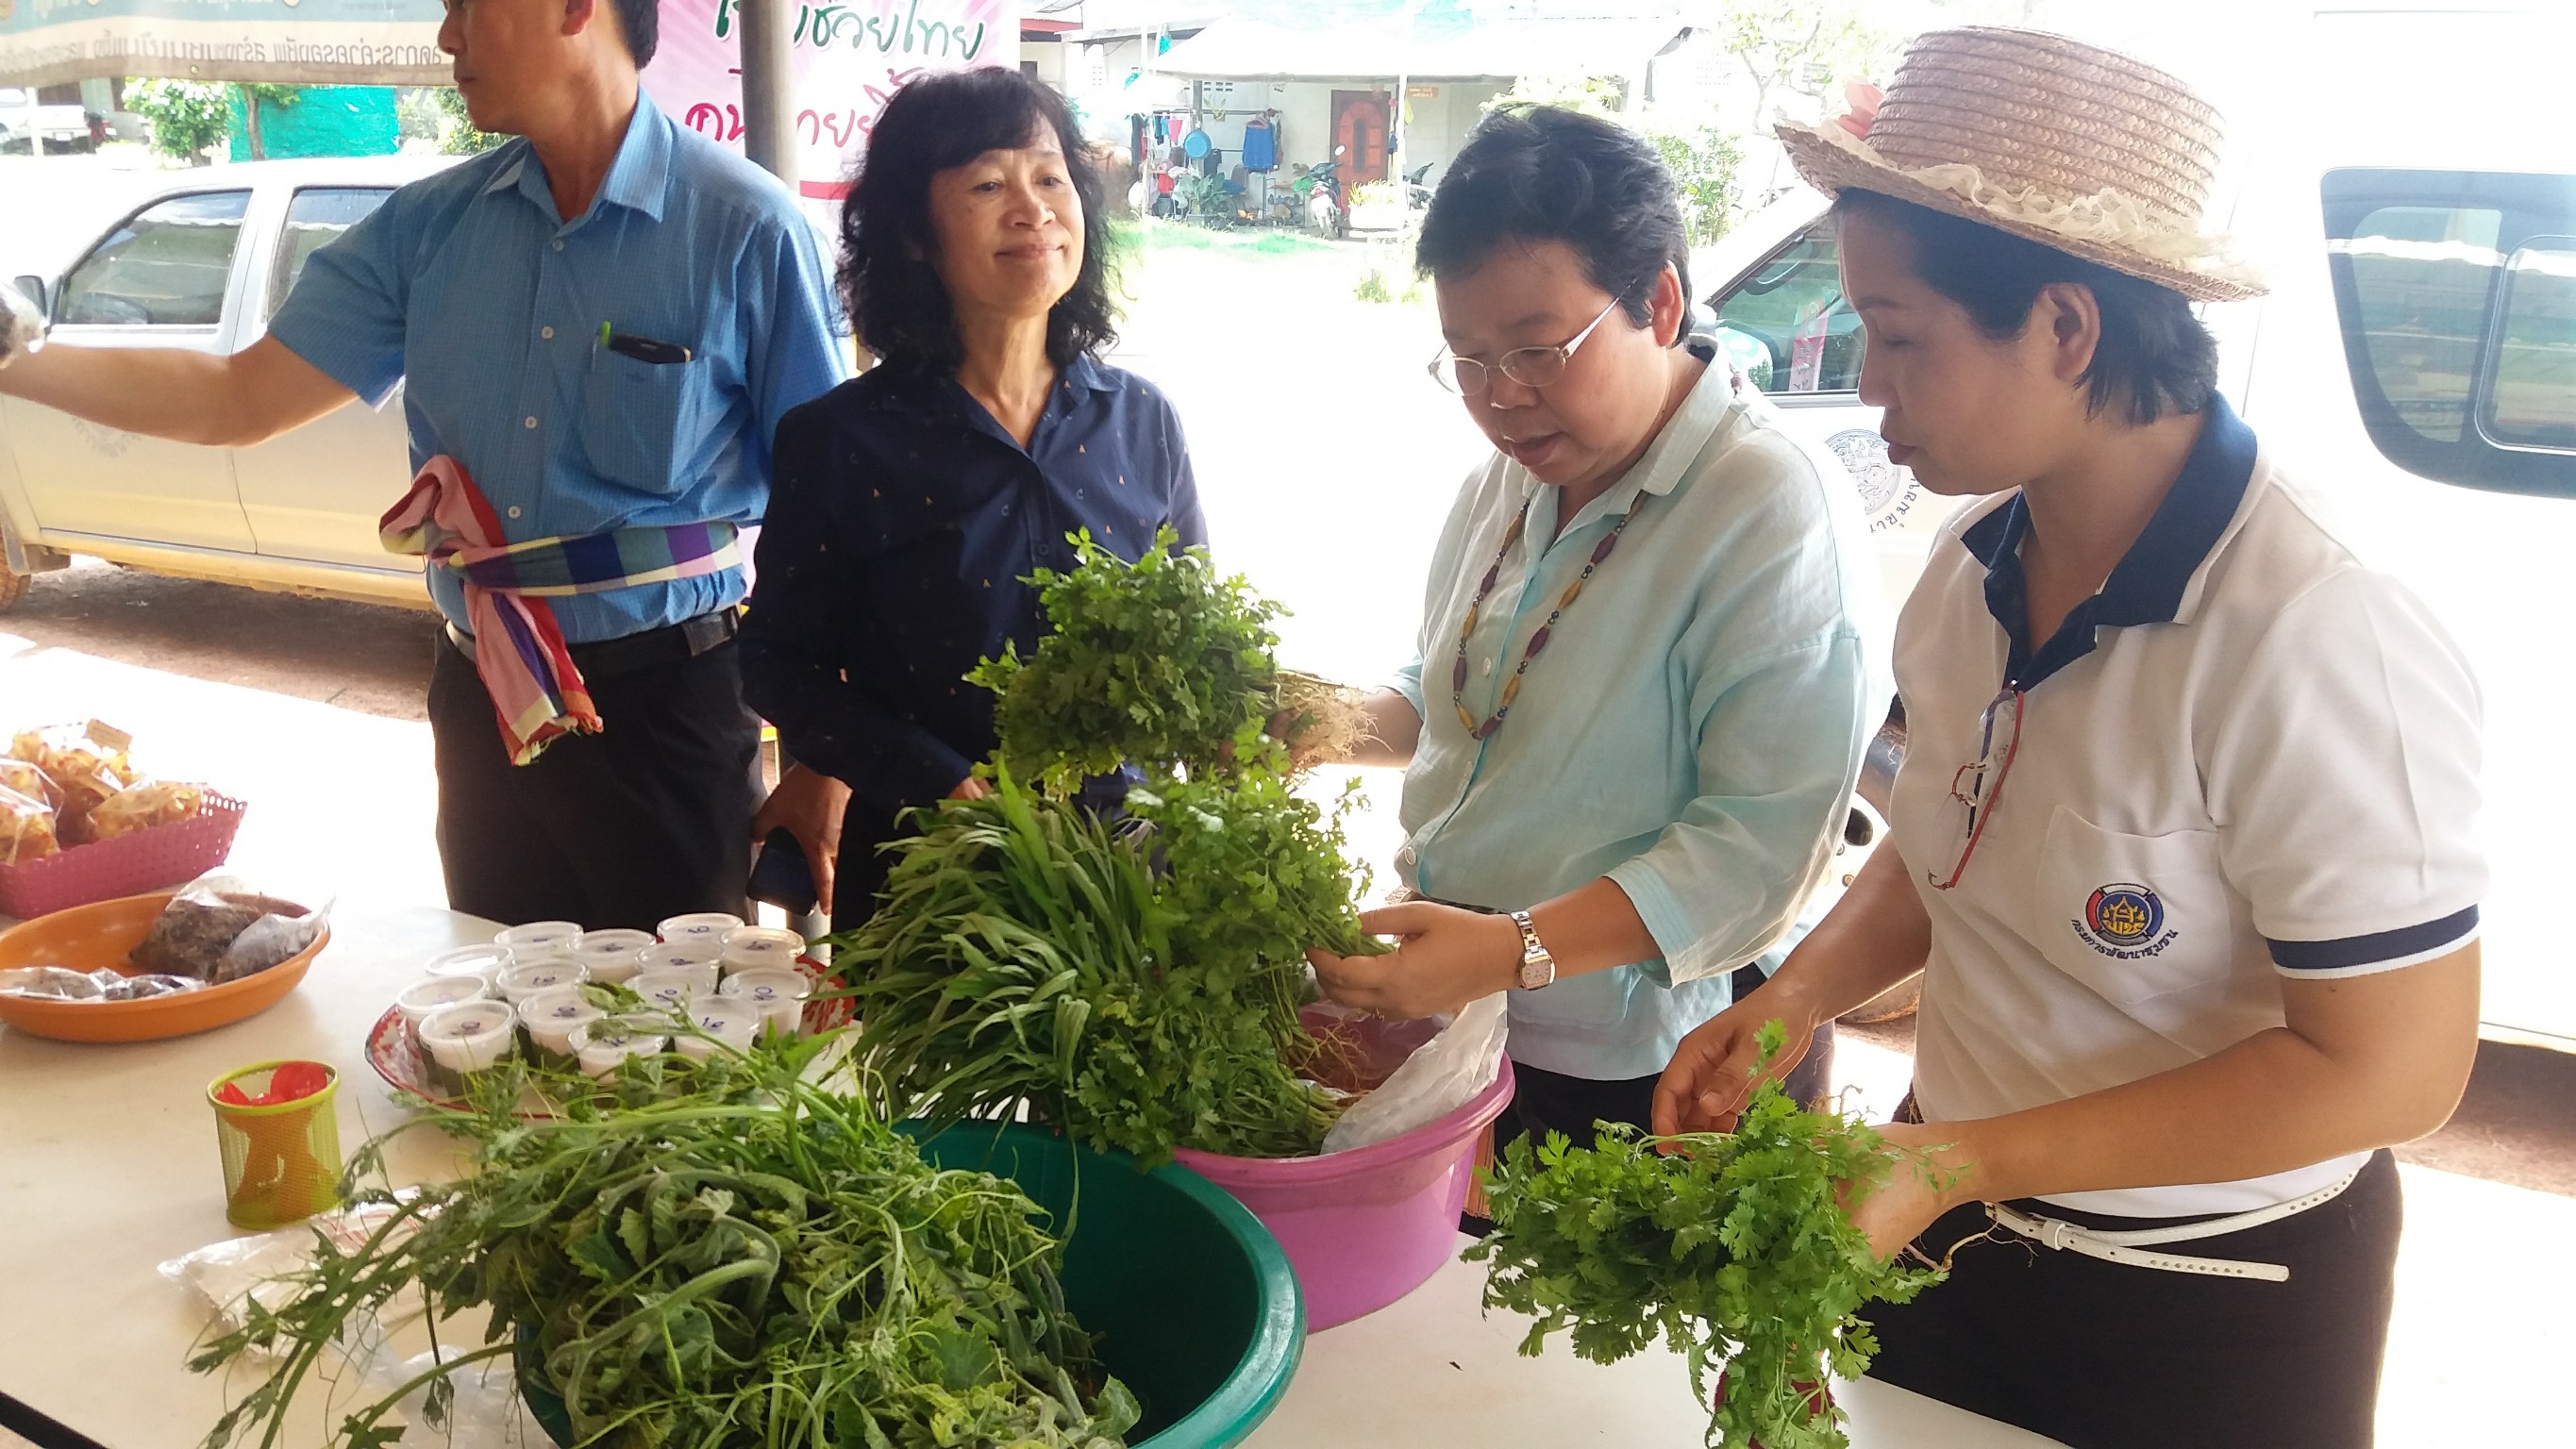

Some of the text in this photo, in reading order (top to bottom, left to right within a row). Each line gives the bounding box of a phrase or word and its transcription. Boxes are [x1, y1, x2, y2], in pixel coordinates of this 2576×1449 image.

[2071, 919, 2179, 960] กรมการพัฒนาชุมชน
